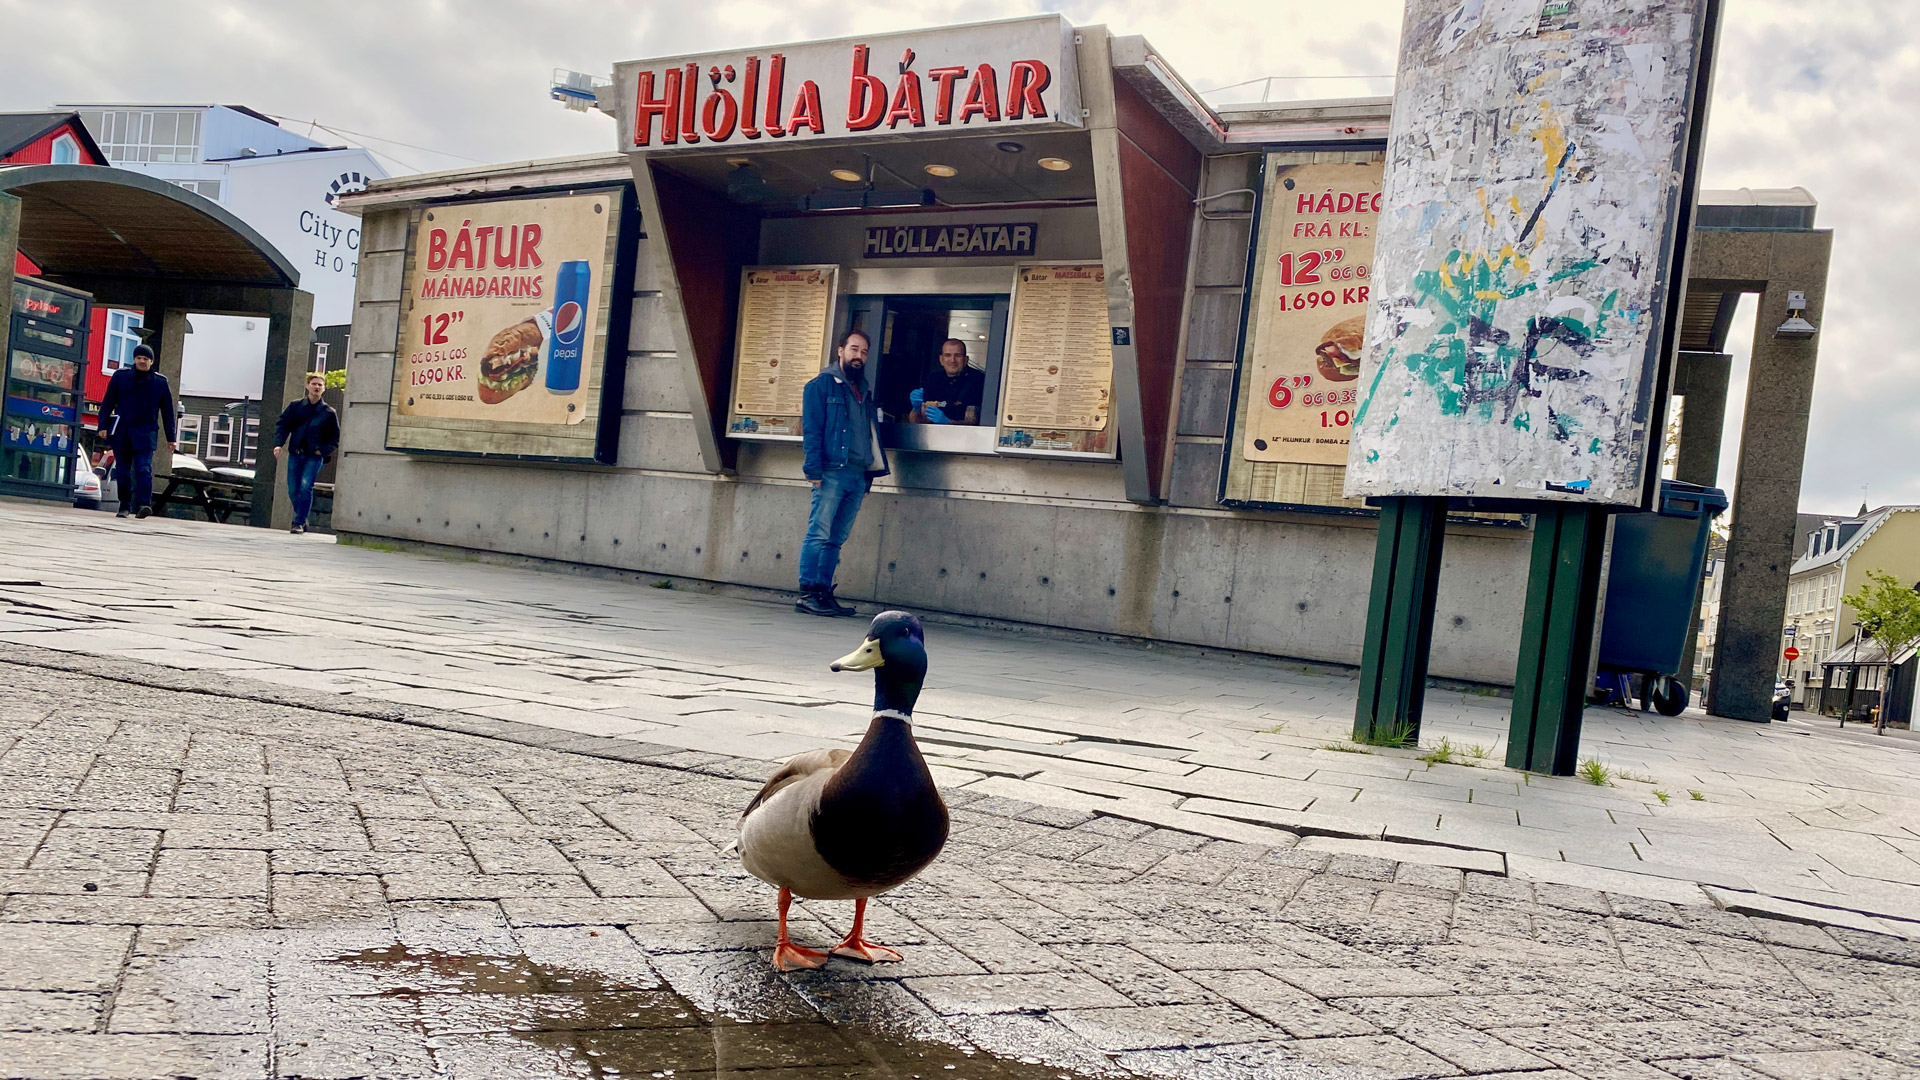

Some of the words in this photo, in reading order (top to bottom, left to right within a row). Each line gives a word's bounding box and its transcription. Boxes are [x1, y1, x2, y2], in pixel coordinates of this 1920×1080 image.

[299, 210, 342, 248] City
[1293, 219, 1332, 237] FRÁ
[1340, 222, 1368, 237] KL:
[427, 219, 543, 271] BÁTUR
[865, 225, 1032, 254] HLÖLLABÁTAR
[1330, 266, 1352, 280] OG
[420, 273, 543, 299] MÁNAÐARINS
[1279, 290, 1335, 311] 1.690
[442, 352, 447, 361] L
[449, 347, 467, 361] GOS
[554, 347, 578, 360] pepsi
[411, 367, 443, 386] 1.690
[446, 365, 466, 382] KR.
[1302, 392, 1323, 405] OG
[1321, 409, 1354, 428] 1.0
